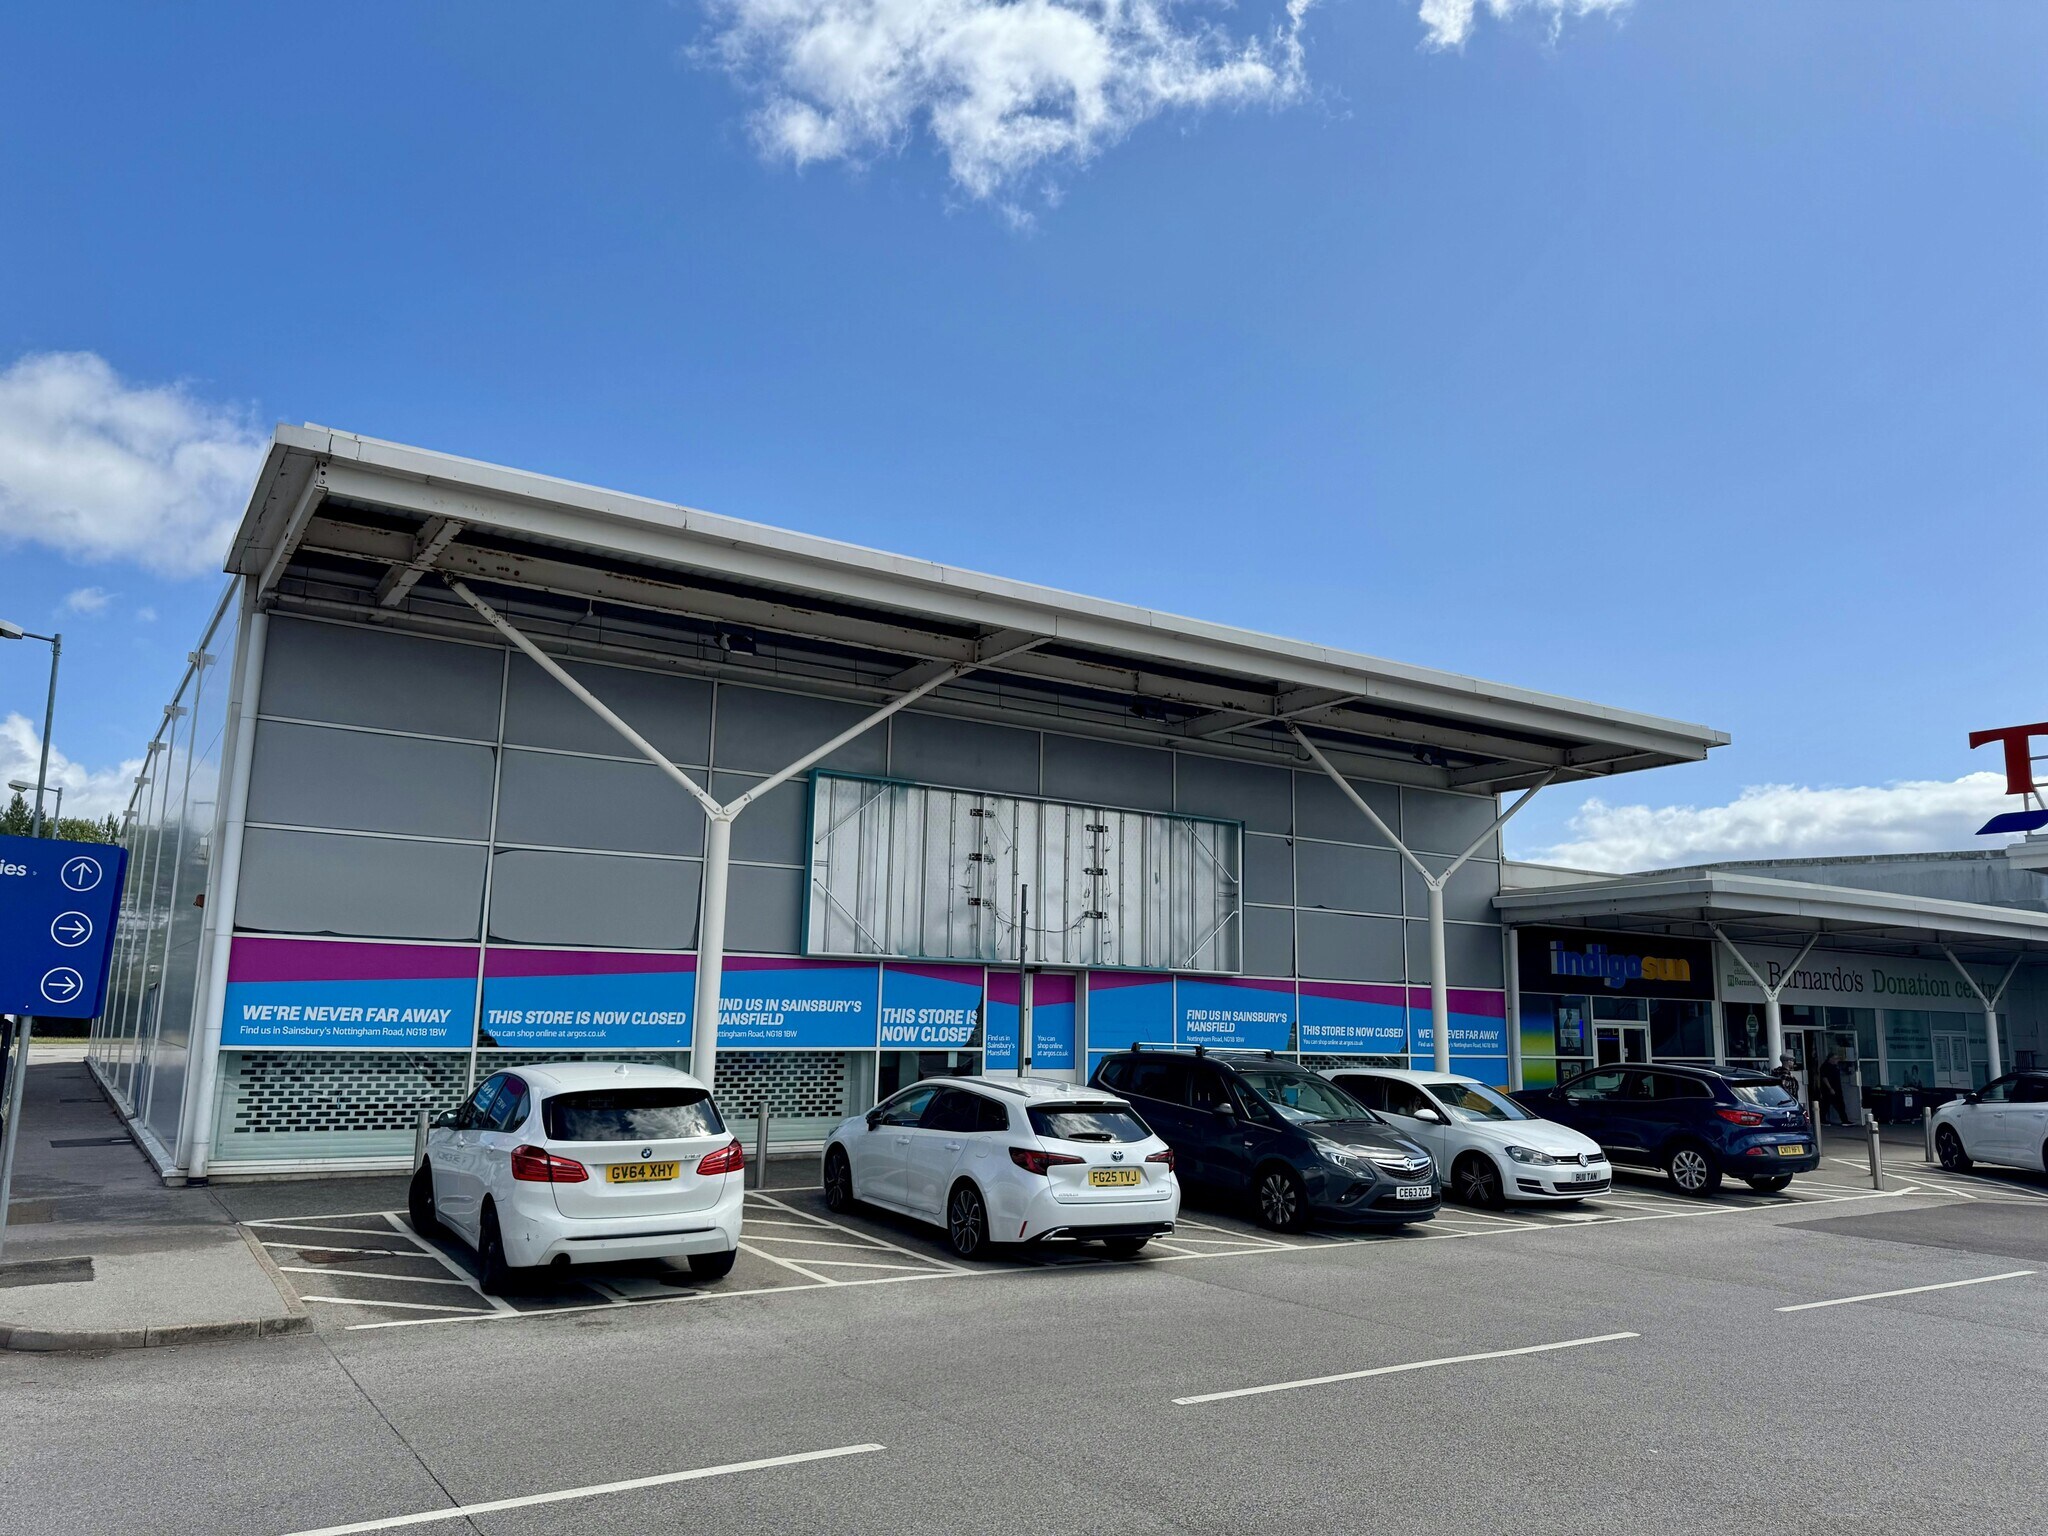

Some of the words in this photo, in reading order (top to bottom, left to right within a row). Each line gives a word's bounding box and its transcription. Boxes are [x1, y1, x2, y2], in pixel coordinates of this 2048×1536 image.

[1969, 722, 2048, 795] T
[0, 859, 27, 876] ies
[1550, 941, 1690, 989] indigosun
[1767, 961, 1864, 992] Barnardo's
[1872, 969, 1951, 997] Donation
[720, 999, 742, 1010] IND
[746, 999, 763, 1011] US
[765, 999, 779, 1011] IN
[781, 1000, 862, 1012] SAINSBURY'S
[243, 1005, 301, 1021] WE'RE
[304, 1006, 362, 1022] NEVER
[366, 1008, 399, 1022] FAR
[400, 1009, 451, 1022] AWAY
[488, 1010, 524, 1024] THIS
[525, 1010, 574, 1024] STORE
[576, 1011, 590, 1024] IS
[593, 1012, 630, 1025] NOW
[632, 1012, 686, 1025] CLOSED
[882, 1008, 916, 1024] THIS
[918, 1009, 964, 1024] STORE
[966, 1010, 978, 1024] IS
[1187, 1010, 1207, 1020] FIND
[1209, 1010, 1220, 1020] US
[1222, 1011, 1231, 1021] IN
[1233, 1011, 1287, 1023] SAINSBURY'S
[240, 1026, 258, 1034] Find
[273, 1026, 280, 1034] in
[282, 1026, 331, 1036] Sainsbury's
[333, 1027, 380, 1037] Nottingham
[382, 1028, 404, 1036] Road,
[406, 1028, 427, 1036] NG18
[429, 1028, 447, 1036] 1BW
[1187, 1022, 1236, 1032] MANSFIELD
[1303, 1026, 1320, 1035] THIS
[1321, 1026, 1345, 1036] STORE
[1347, 1027, 1354, 1036] IS
[1356, 1028, 1374, 1037] NOW
[1375, 1028, 1403, 1038] CLOSED
[517, 1030, 534, 1038] shop
[567, 1030, 606, 1038] argos.co.uk
[718, 1030, 746, 1039] ttingham
[748, 1030, 764, 1038] Road,
[882, 1026, 917, 1042] NOW
[1418, 1029, 1433, 1038] WE'
[1448, 1030, 1464, 1039] EVER
[1466, 1030, 1478, 1039] FAR
[1480, 1031, 1499, 1039] AWAY
[612, 1165, 645, 1179] GV64
[650, 1164, 674, 1177] XHY
[1092, 1172, 1117, 1183] FG25
[1119, 1171, 1136, 1182] TVJ
[1400, 1188, 1417, 1197] CE63
[1418, 1187, 1430, 1196] ZCZ
